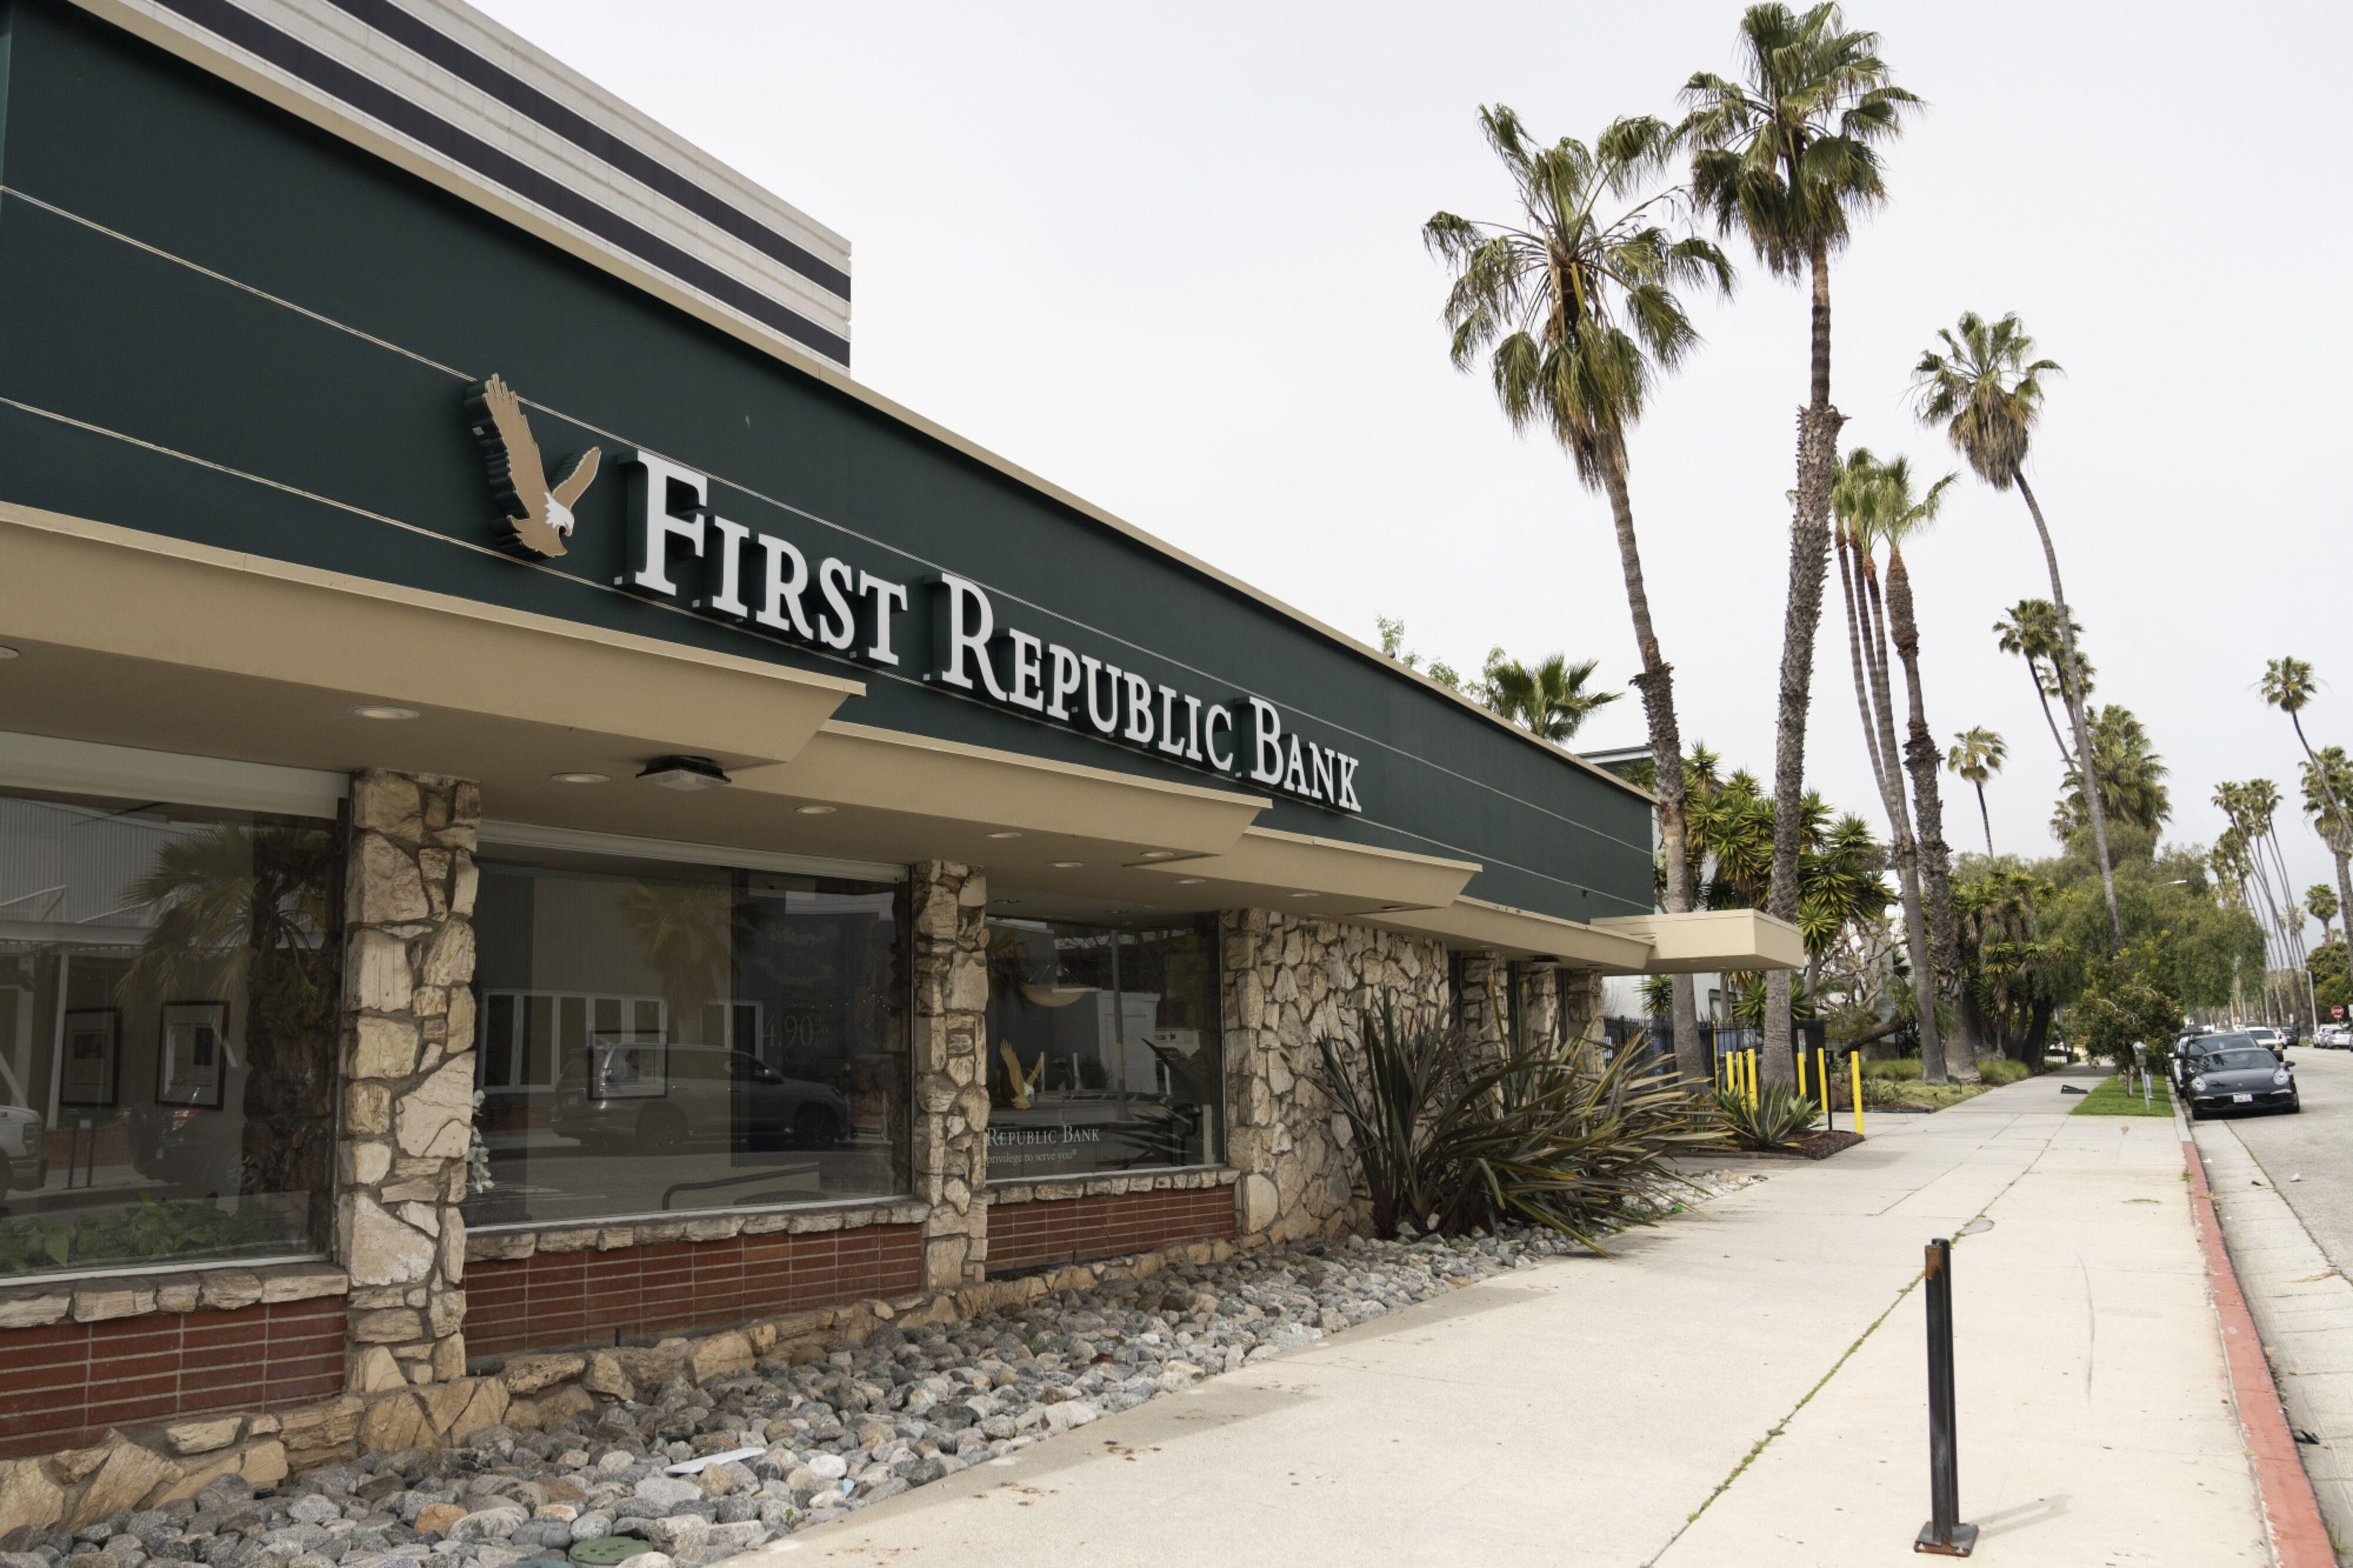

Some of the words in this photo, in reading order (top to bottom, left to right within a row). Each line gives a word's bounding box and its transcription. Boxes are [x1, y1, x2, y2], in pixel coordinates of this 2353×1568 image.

[635, 450, 908, 665] FIRST
[942, 573, 1234, 772] REPUBLIC
[1249, 697, 1361, 812] BANK
[986, 1127, 1057, 1146] REPUBLIC
[1062, 1125, 1101, 1143] BANK
[986, 1152, 1022, 1167] privilege
[1035, 1152, 1055, 1162] serve
